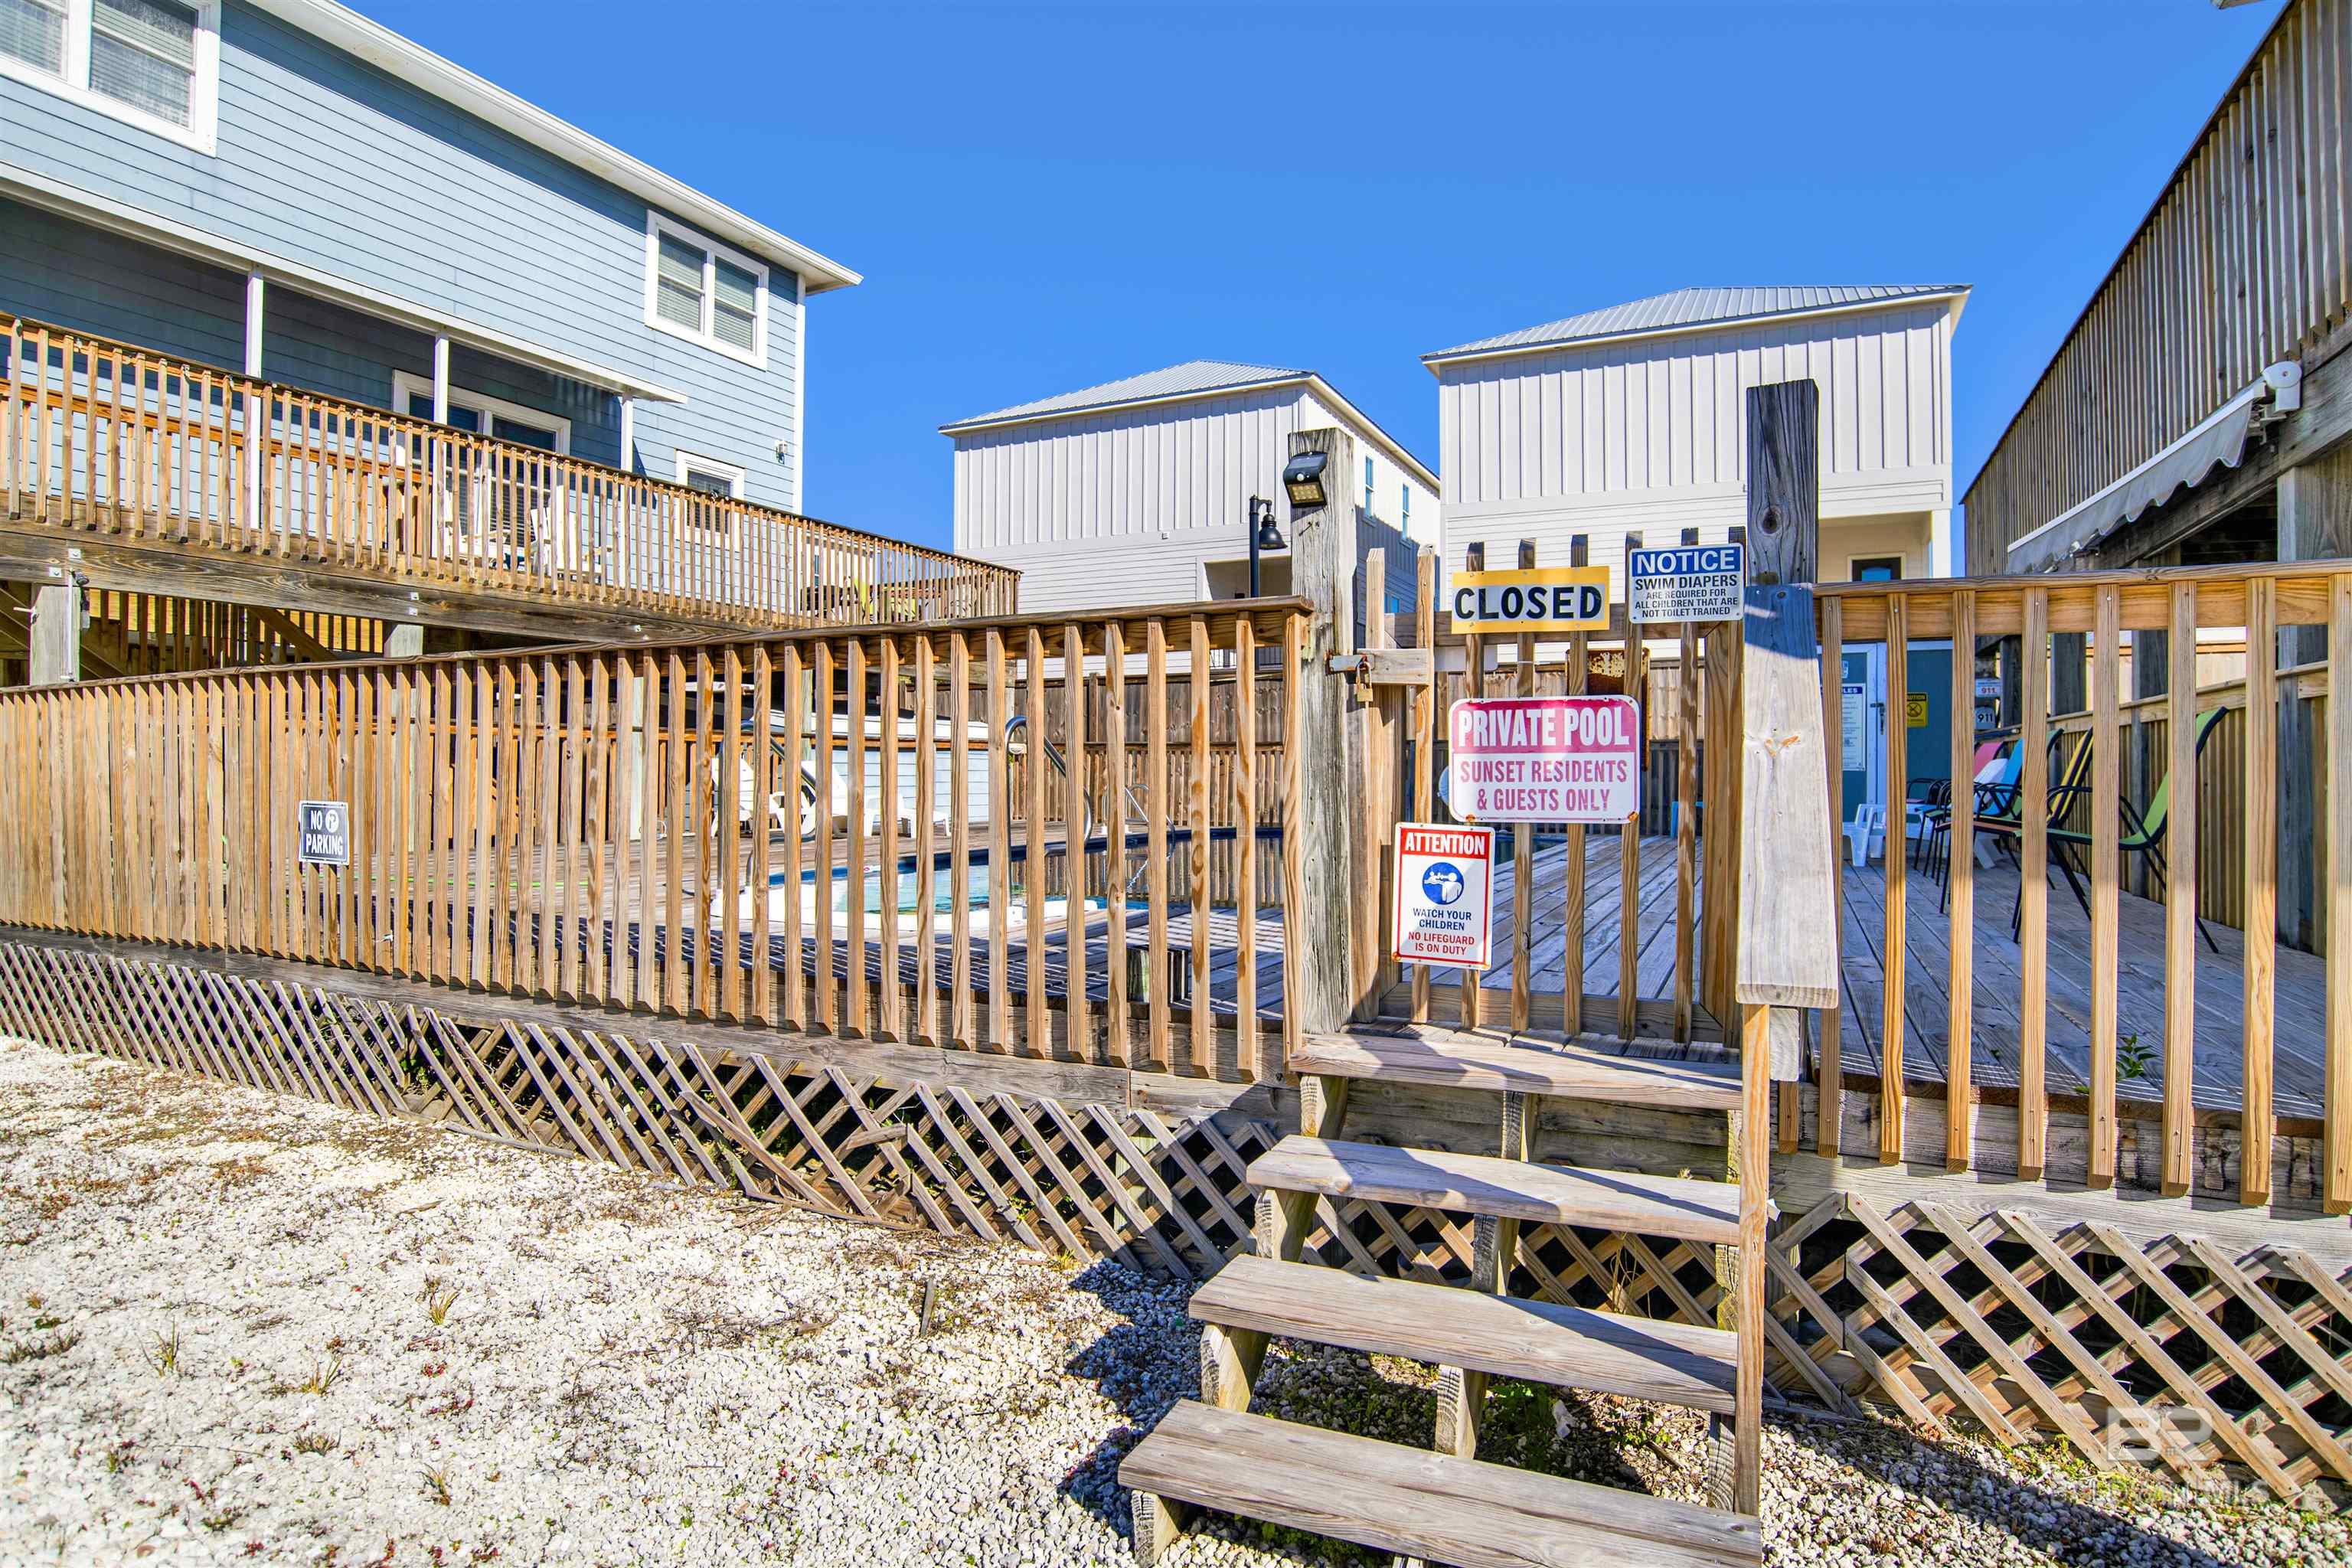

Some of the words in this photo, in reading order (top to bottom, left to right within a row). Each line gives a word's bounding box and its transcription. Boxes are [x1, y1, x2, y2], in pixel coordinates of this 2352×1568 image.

[1637, 550, 1735, 574] NOTICE
[1635, 577, 1674, 590] SWIM
[1679, 575, 1737, 588] DIAPERS
[1665, 590, 1707, 599] REQUIRED
[1455, 586, 1602, 619] CLOSED
[1635, 601, 1649, 609] ALL
[1652, 599, 1694, 609] CHILDREN
[1697, 598, 1718, 606] THAT
[1642, 609, 1658, 618] NOT
[1662, 608, 1692, 616] TOILET
[1693, 606, 1730, 616] TRAINED
[1978, 713, 1993, 723] 911
[1459, 709, 1557, 747] PRIVATE
[1564, 707, 1630, 746] POOL
[1460, 760, 1525, 783] SUNSET
[1532, 760, 1627, 782] RESIDENTS
[1478, 789, 1488, 810] &
[1494, 789, 1559, 811] GUESTS
[1566, 789, 1610, 811] ONLY
[311, 810, 322, 830] NO
[306, 833, 343, 855] PARKING
[1406, 832, 1485, 855] ATTENTION
[1413, 908, 1444, 919] WATCH
[1447, 910, 1472, 920] YOUR
[1419, 919, 1465, 930] CHILDREN
[1409, 932, 1421, 940] NO
[1424, 933, 1475, 945] LIFEGUARD
[1427, 944, 1439, 953] ON
[1442, 946, 1466, 956] DUTY
